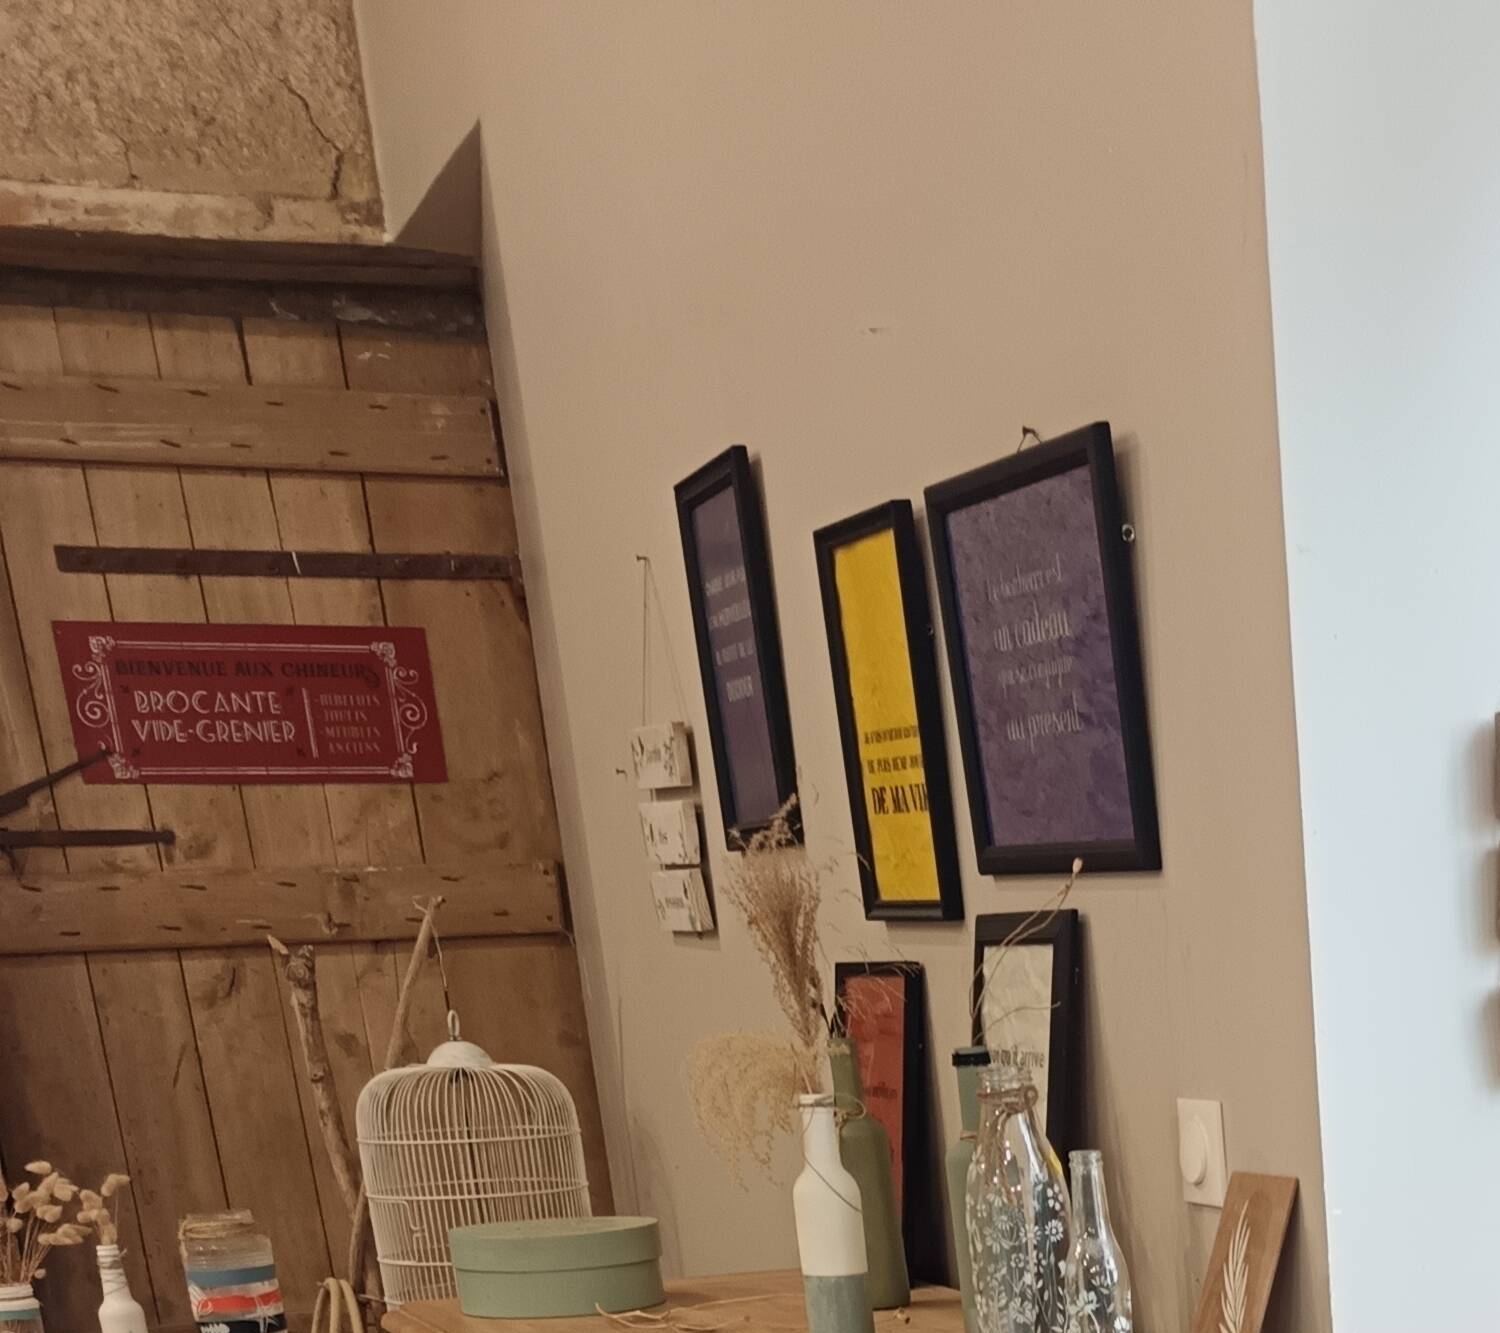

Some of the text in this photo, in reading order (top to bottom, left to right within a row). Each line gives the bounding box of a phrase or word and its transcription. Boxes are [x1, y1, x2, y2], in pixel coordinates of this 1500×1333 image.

[1014, 599, 1074, 649] cadeau
[115, 660, 382, 689] BIENVENUE AUX CHINEURS
[133, 689, 283, 716] BROCANTE
[130, 718, 297, 744] VIDE-GRENIER
